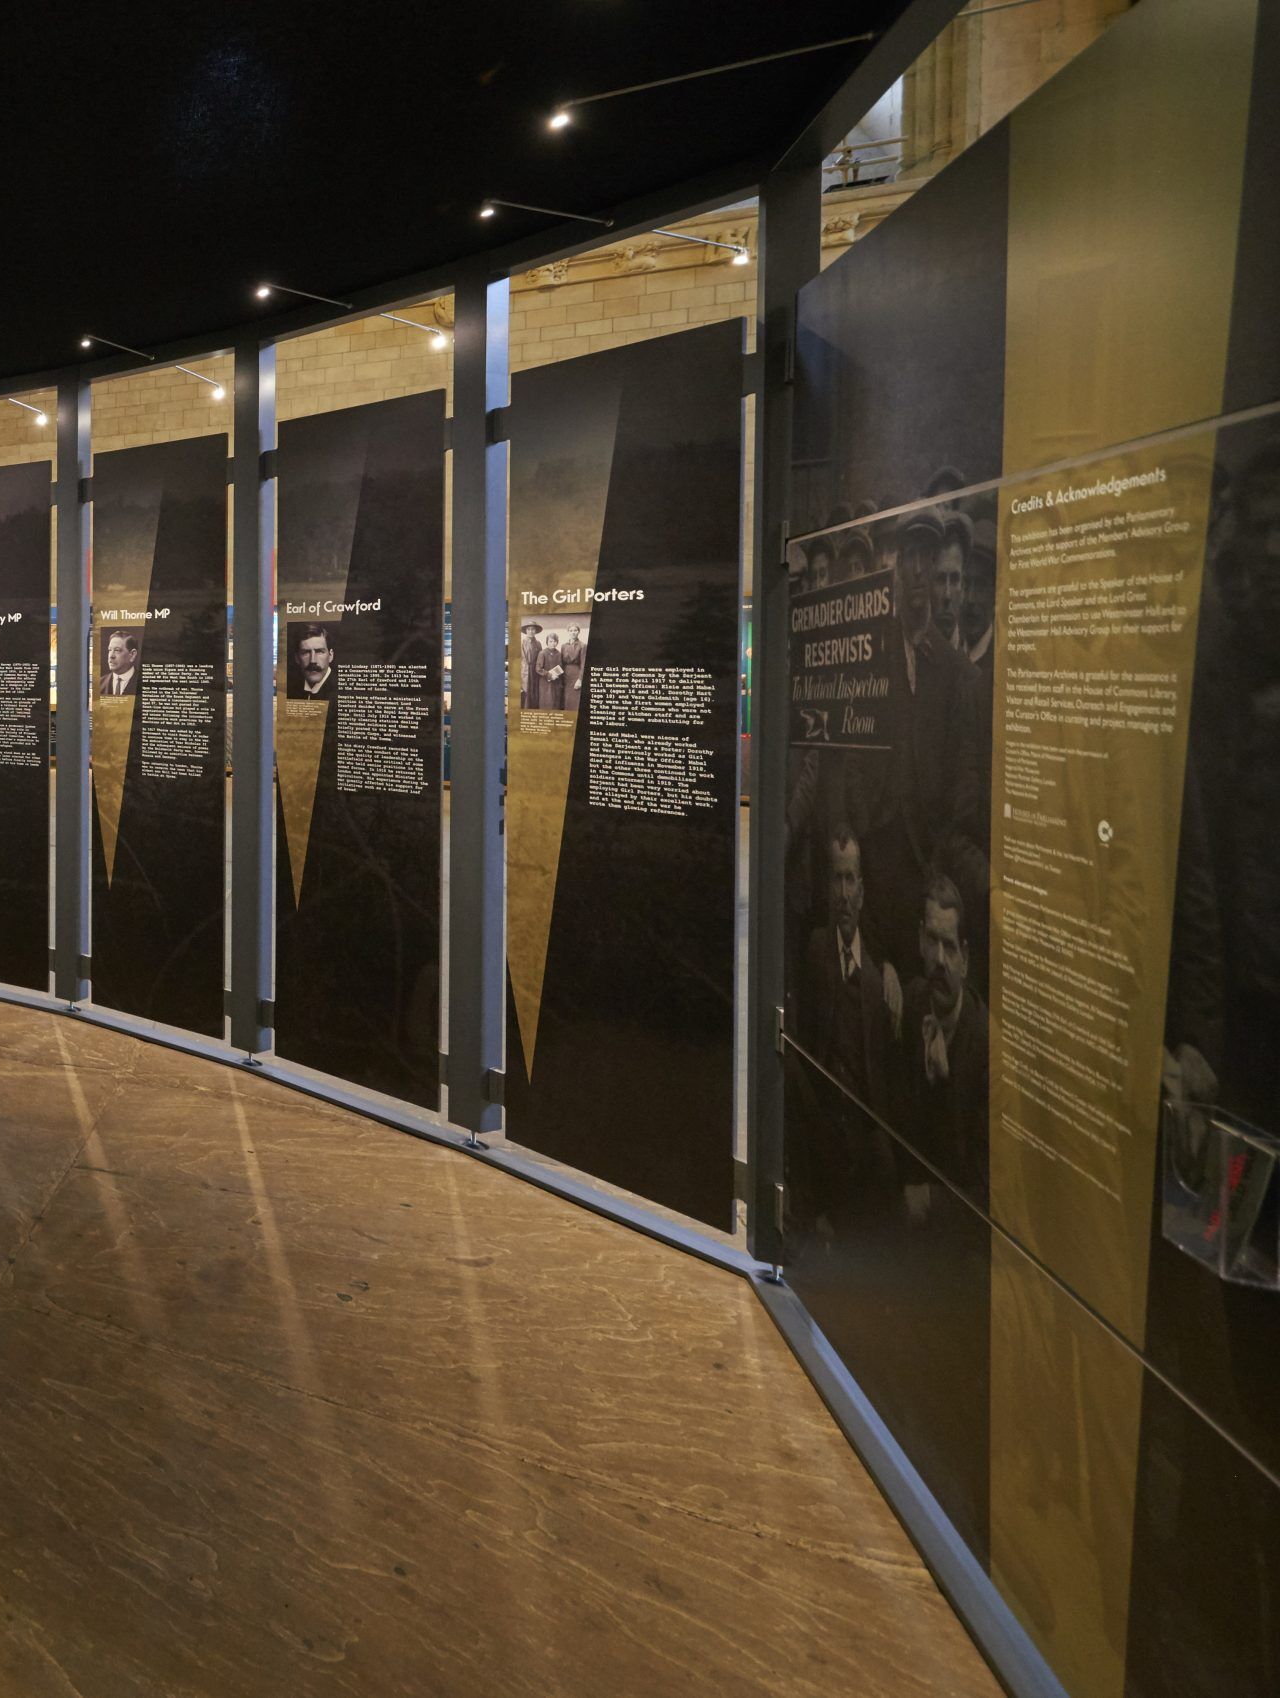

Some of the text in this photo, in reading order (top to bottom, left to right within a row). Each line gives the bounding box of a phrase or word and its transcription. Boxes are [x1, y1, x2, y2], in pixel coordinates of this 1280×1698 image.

[1012, 467, 1166, 514] Credits & Acknowledgements
[1059, 526, 1072, 535] been
[1104, 516, 1112, 528] by
[1113, 516, 1125, 525] the
[1126, 506, 1175, 522] Parliamentary
[1056, 539, 1078, 550] support
[1079, 536, 1086, 546] of
[1086, 536, 1097, 546] the
[1131, 527, 1162, 538] Advisory
[1164, 521, 1190, 533] Group
[1031, 558, 1048, 568] World
[1049, 555, 1060, 564] War
[286, 598, 380, 616] Earl of Crawford
[521, 588, 644, 604] The Girl Porters
[792, 587, 889, 632] GRENADIER GUARDS
[8, 613, 22, 622] MP
[100, 608, 170, 620] Will Thorne MP
[805, 634, 872, 668] RESERVISTS
[792, 673, 888, 704] To Medical Inspection
[648, 718, 690, 726] substituting
[841, 705, 874, 734] Room
